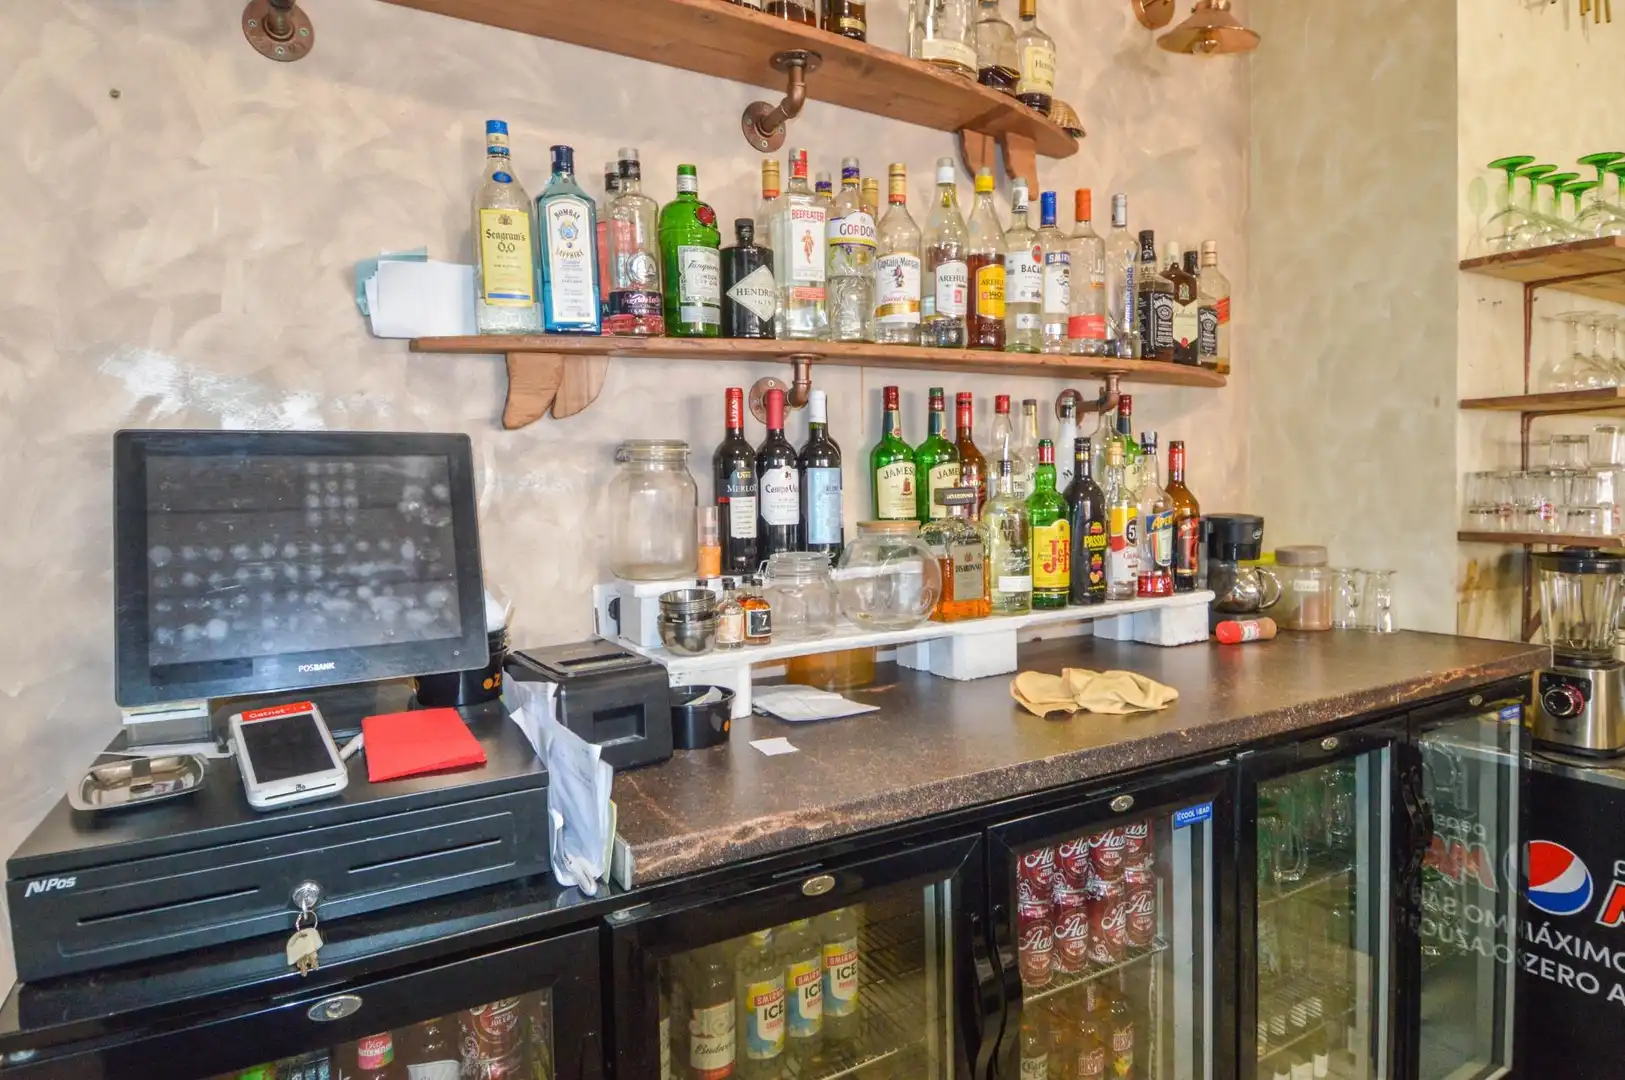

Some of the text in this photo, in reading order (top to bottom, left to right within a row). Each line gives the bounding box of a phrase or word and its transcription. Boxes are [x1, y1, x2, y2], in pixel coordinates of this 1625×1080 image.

[792, 209, 825, 221] BEEFEATER
[486, 228, 526, 243] Seagram's
[878, 258, 899, 270] Captain
[762, 615, 768, 627] 7
[298, 662, 336, 673] POSBANK
[836, 963, 857, 980] ICE
[1525, 952, 1599, 995] ZERO
[764, 1000, 784, 1021] ICE
